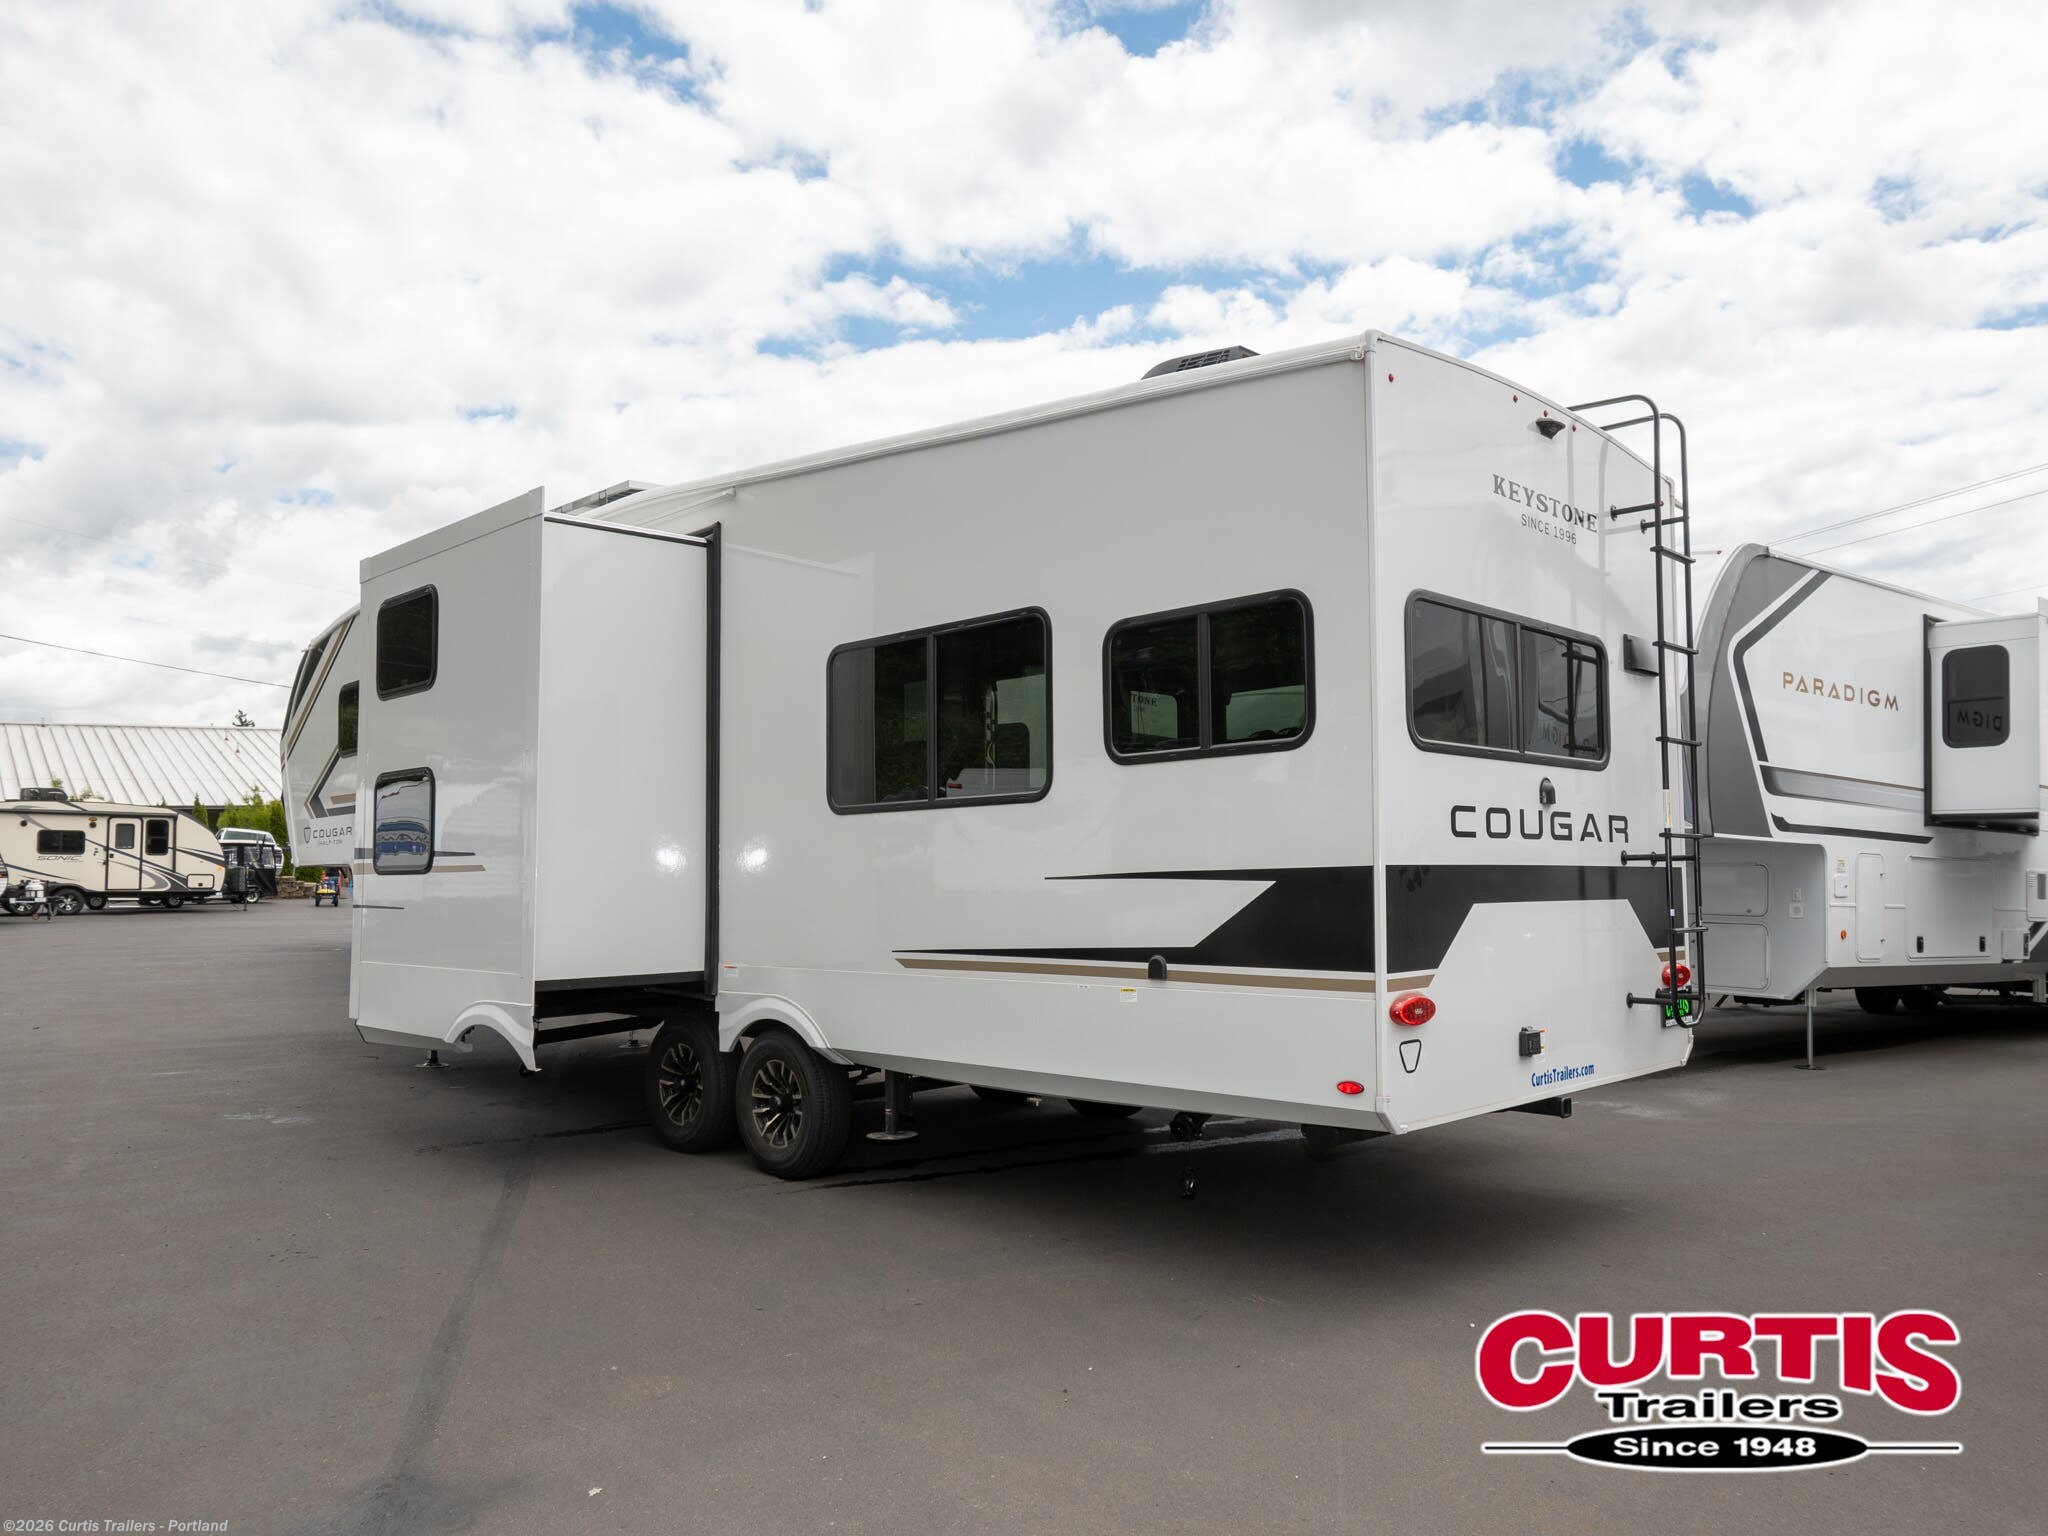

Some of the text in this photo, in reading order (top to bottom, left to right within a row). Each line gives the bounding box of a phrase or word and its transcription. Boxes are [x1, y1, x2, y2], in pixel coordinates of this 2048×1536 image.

[1493, 474, 1597, 533] KEYSTONE
[1521, 514, 1577, 545] SINCE 1996
[1783, 671, 1899, 712] PARADIGM
[312, 826, 353, 839] COUGAR
[1451, 805, 1629, 843] COUGAR
[1531, 1064, 1595, 1087] CurtisTrailers.com
